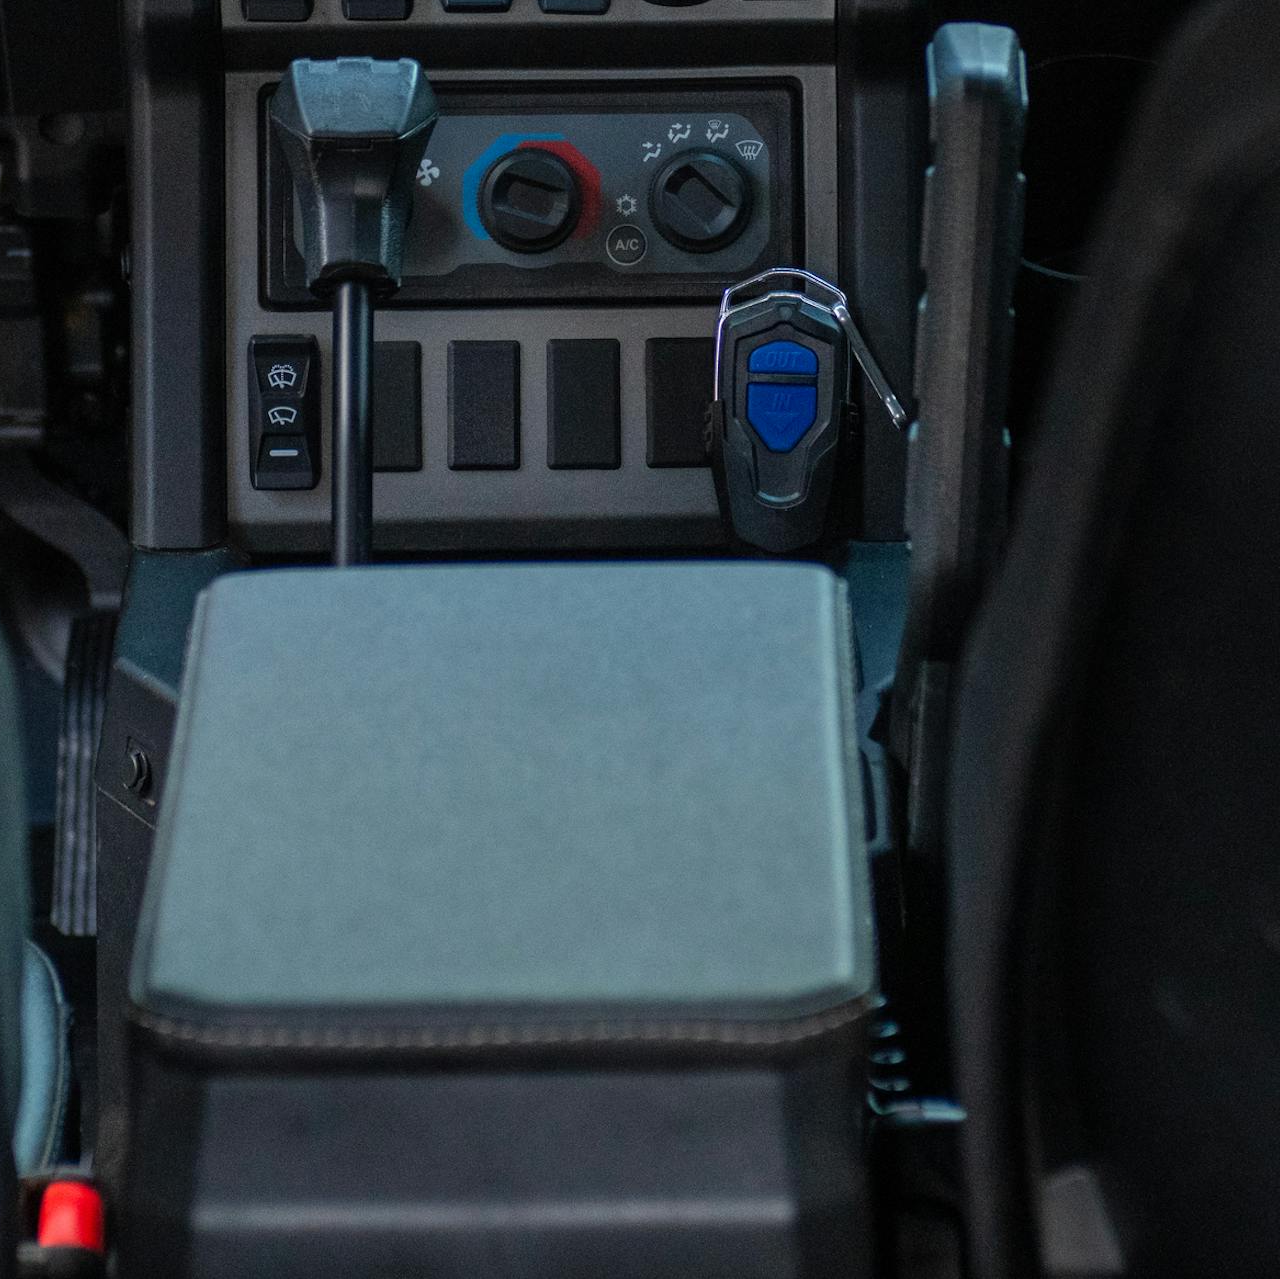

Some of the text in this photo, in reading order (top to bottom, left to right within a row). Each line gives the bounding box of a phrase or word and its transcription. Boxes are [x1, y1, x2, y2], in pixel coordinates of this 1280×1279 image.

[615, 238, 640, 251] A/C
[766, 351, 802, 368] OUT
[771, 392, 792, 410] IN
